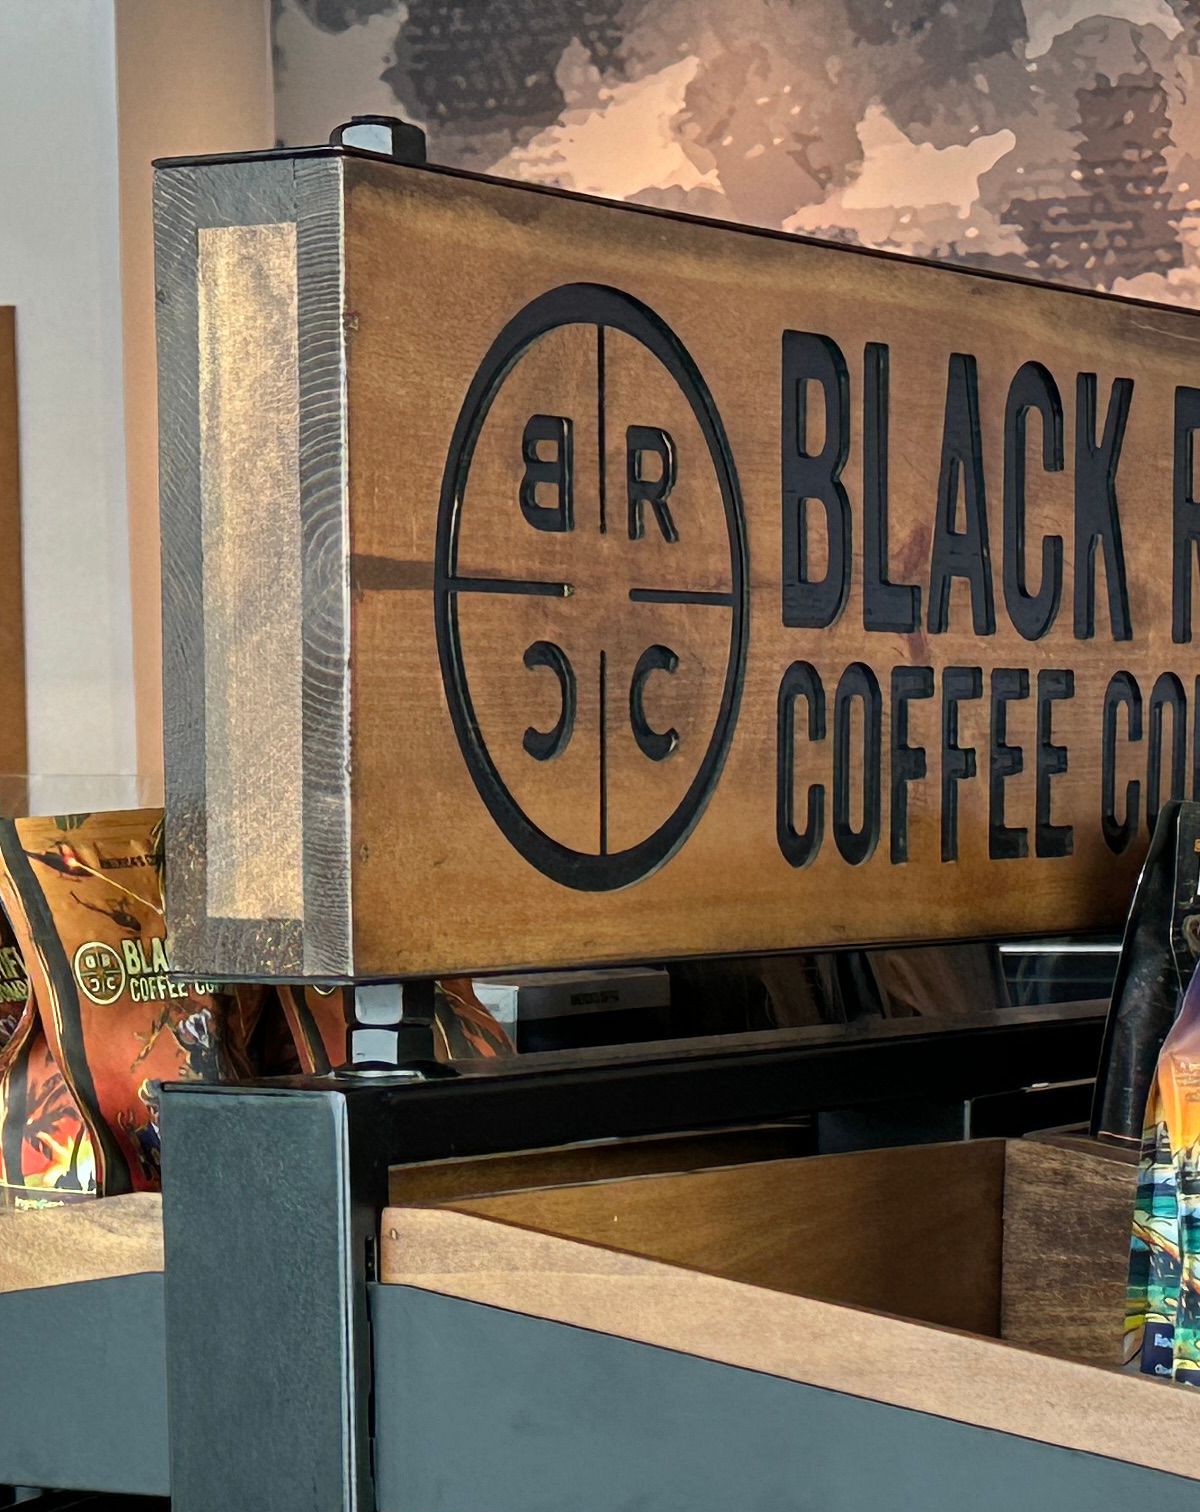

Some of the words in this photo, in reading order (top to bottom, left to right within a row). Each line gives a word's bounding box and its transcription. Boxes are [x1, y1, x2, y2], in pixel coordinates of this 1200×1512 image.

[780, 328, 1134, 644] BLACK
[775, 660, 1077, 868] COFFEE
[1102, 669, 1200, 855] CO
[121, 937, 169, 975] BLA
